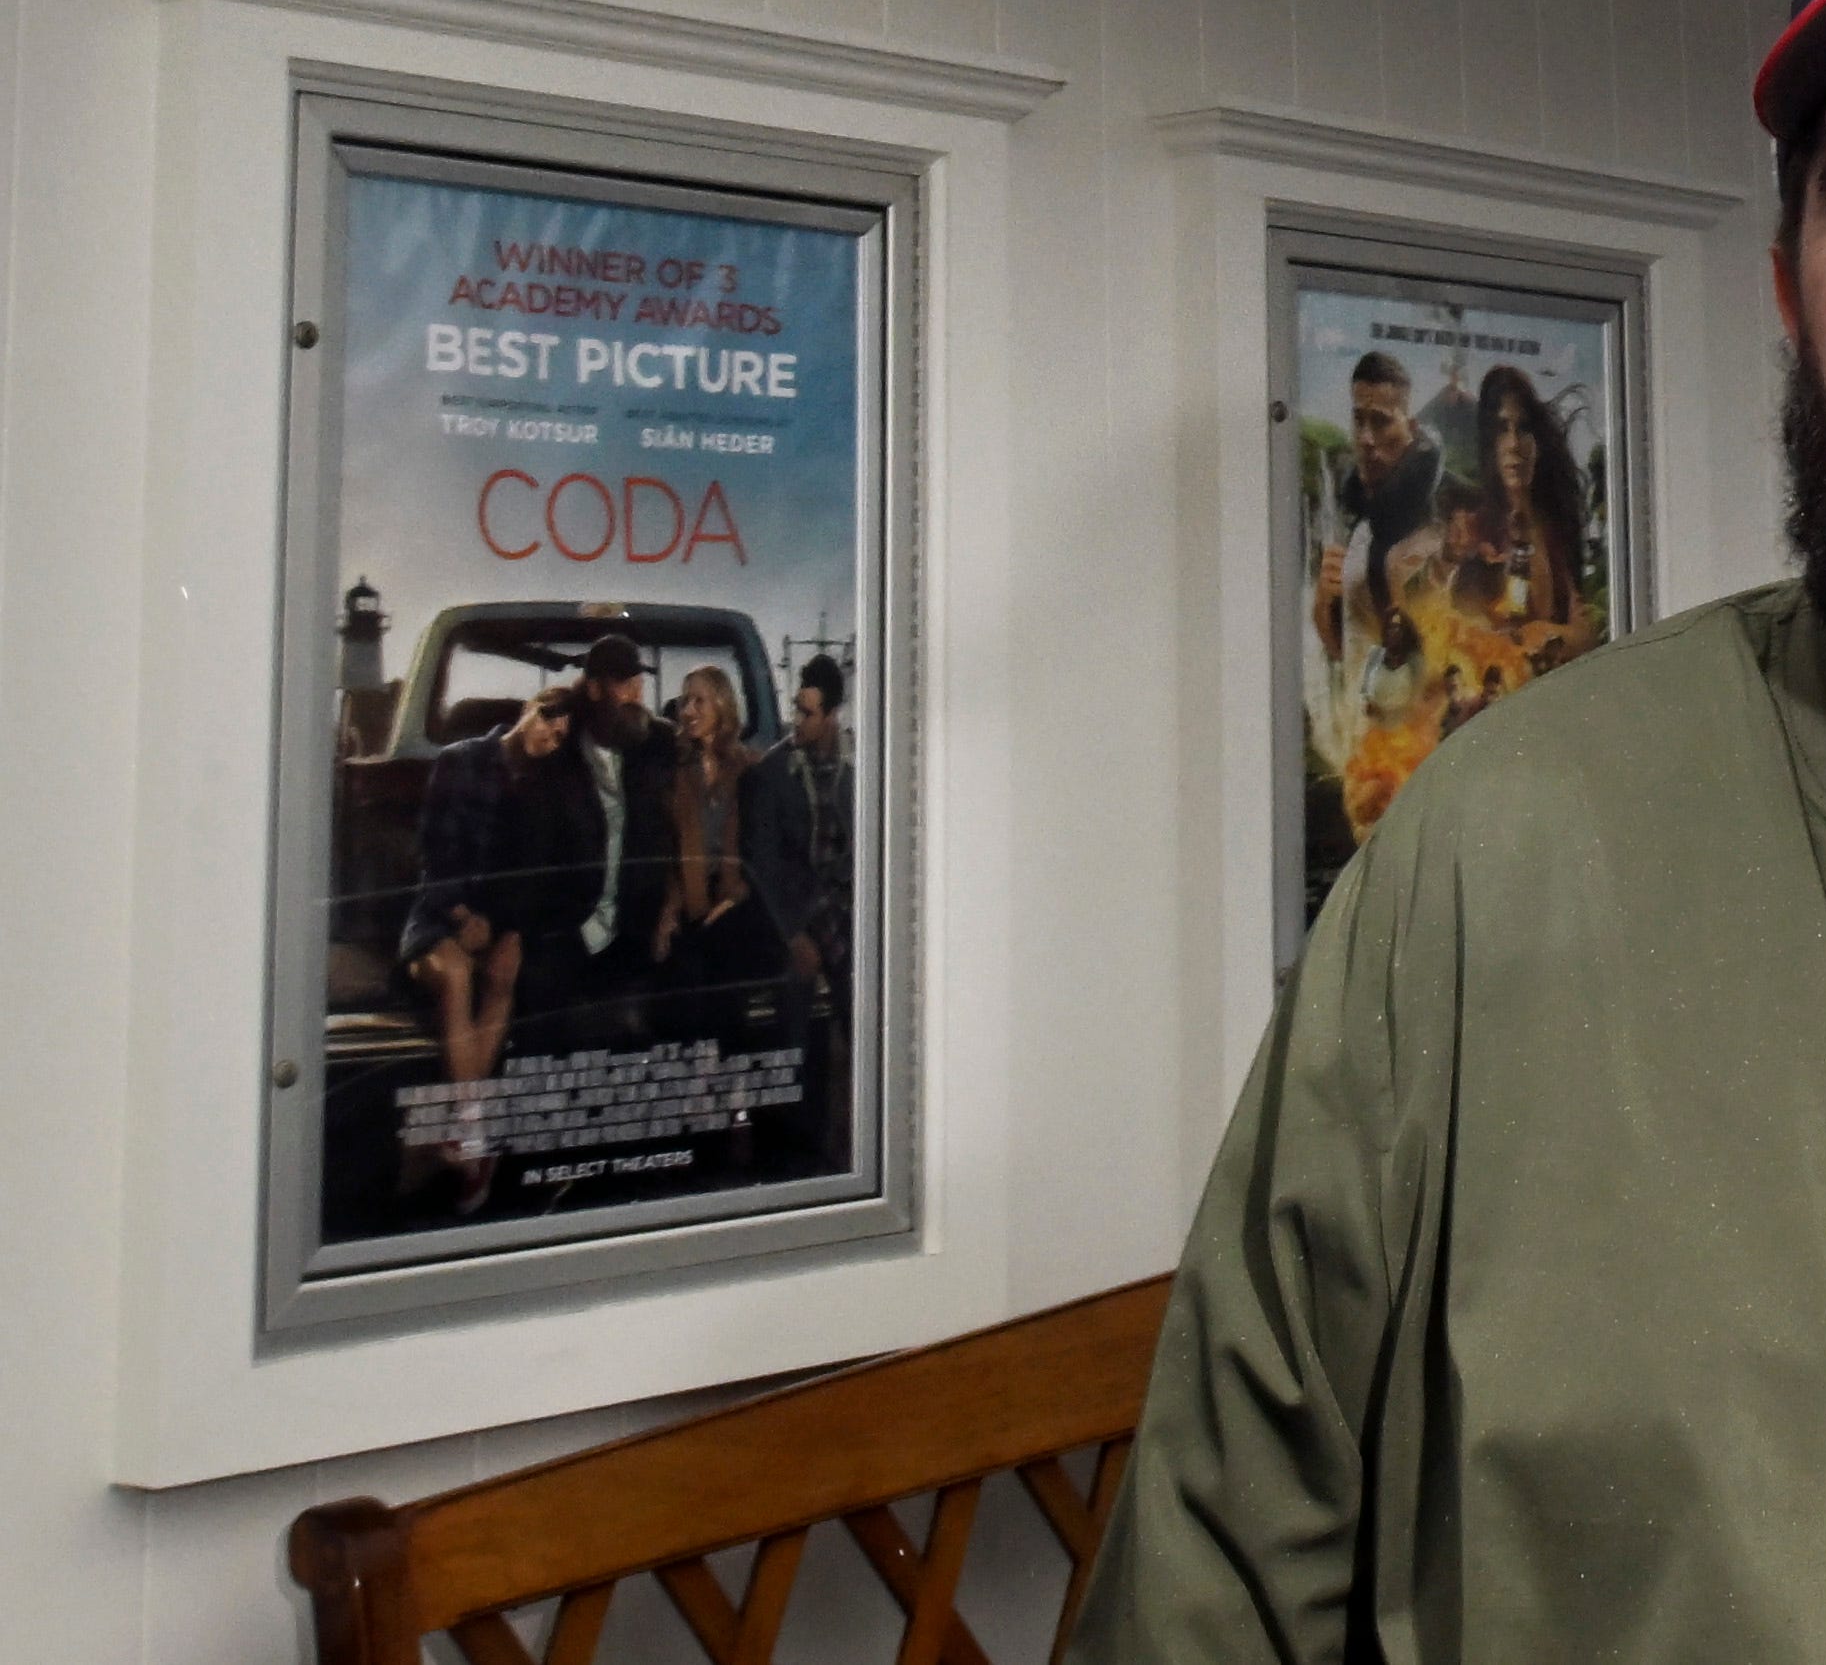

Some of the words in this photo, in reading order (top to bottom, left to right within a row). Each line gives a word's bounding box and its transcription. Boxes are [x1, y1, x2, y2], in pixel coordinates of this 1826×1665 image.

[494, 240, 647, 284] WINNER
[656, 258, 705, 291] OF
[719, 264, 738, 293] 3
[448, 275, 629, 322] ACADEMY
[634, 297, 783, 336] AWARDS
[426, 323, 560, 380] BEST
[576, 338, 798, 398] PICTURE
[700, 432, 776, 455] HEDER
[477, 467, 748, 566] CODA
[521, 1169, 543, 1185] IN
[545, 1159, 609, 1183] SELECT
[612, 1149, 695, 1174] THEATERS
